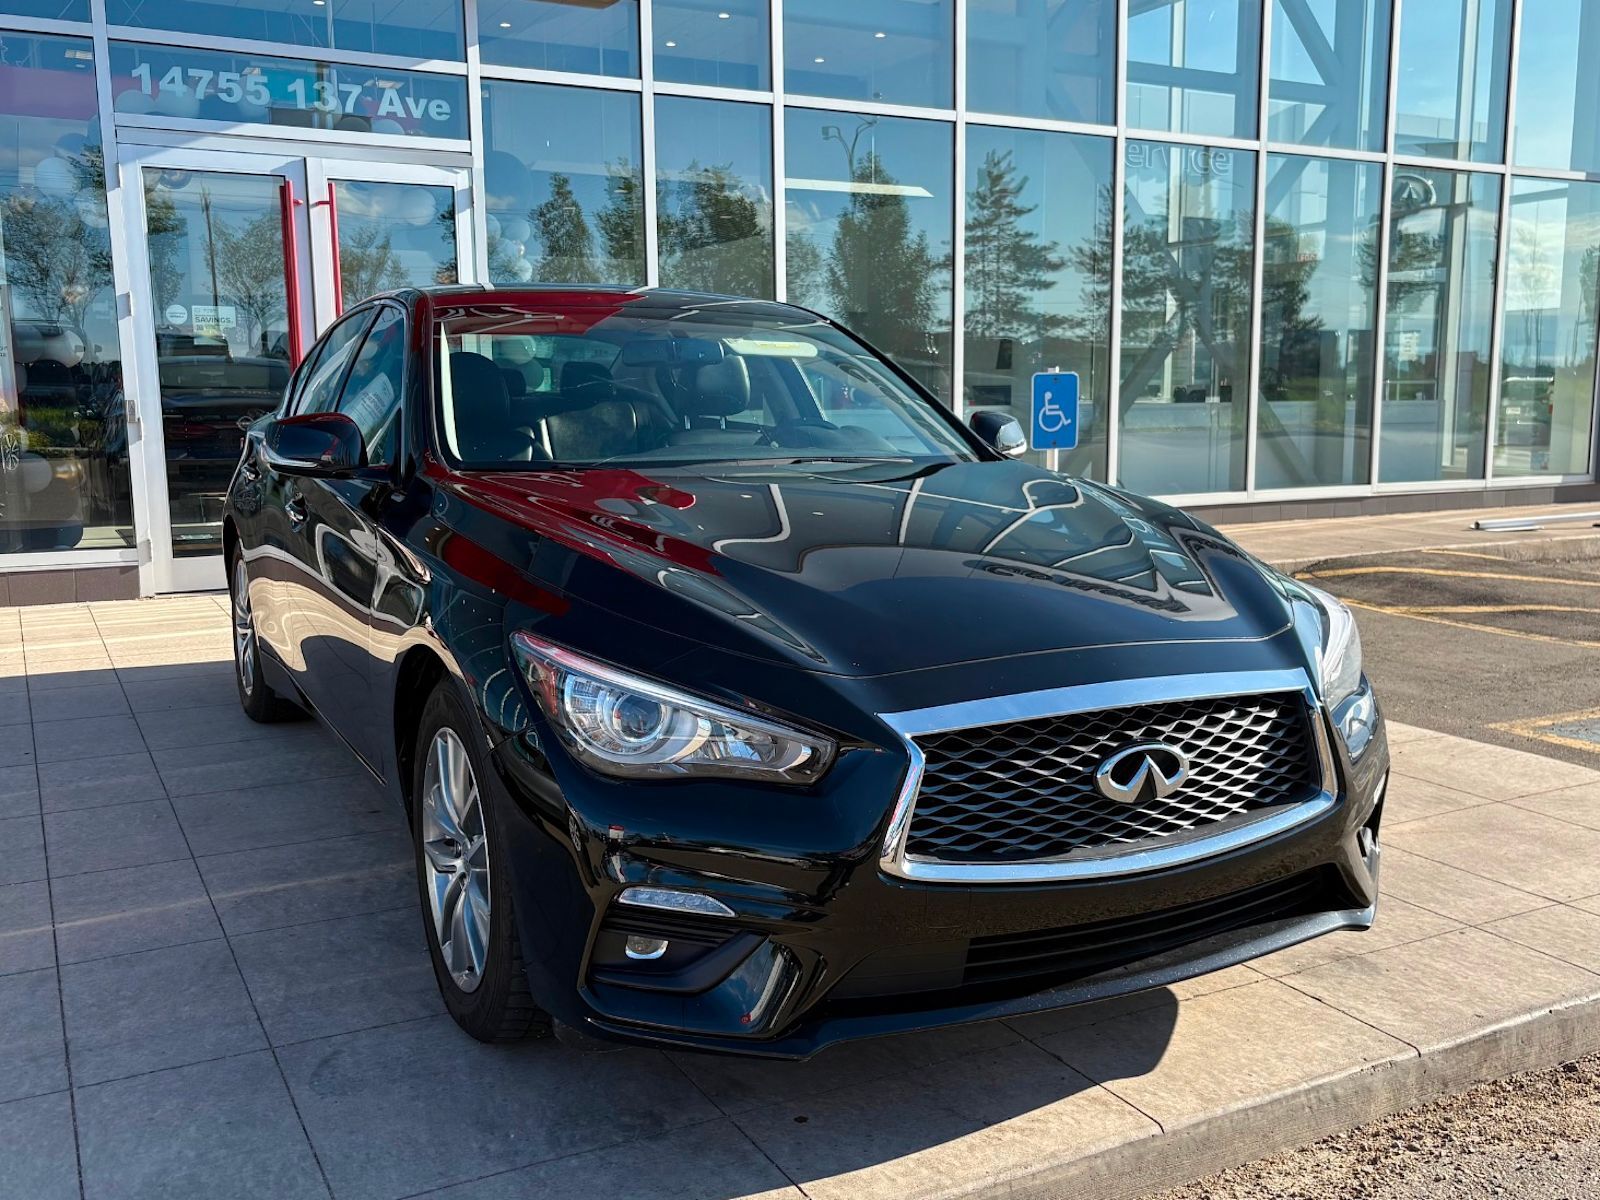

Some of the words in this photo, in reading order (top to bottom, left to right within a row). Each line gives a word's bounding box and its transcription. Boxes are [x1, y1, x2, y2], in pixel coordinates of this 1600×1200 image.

[131, 62, 271, 106] 14755
[287, 78, 364, 114] 137
[376, 88, 451, 121] Ave
[1125, 143, 1233, 176] ervice
